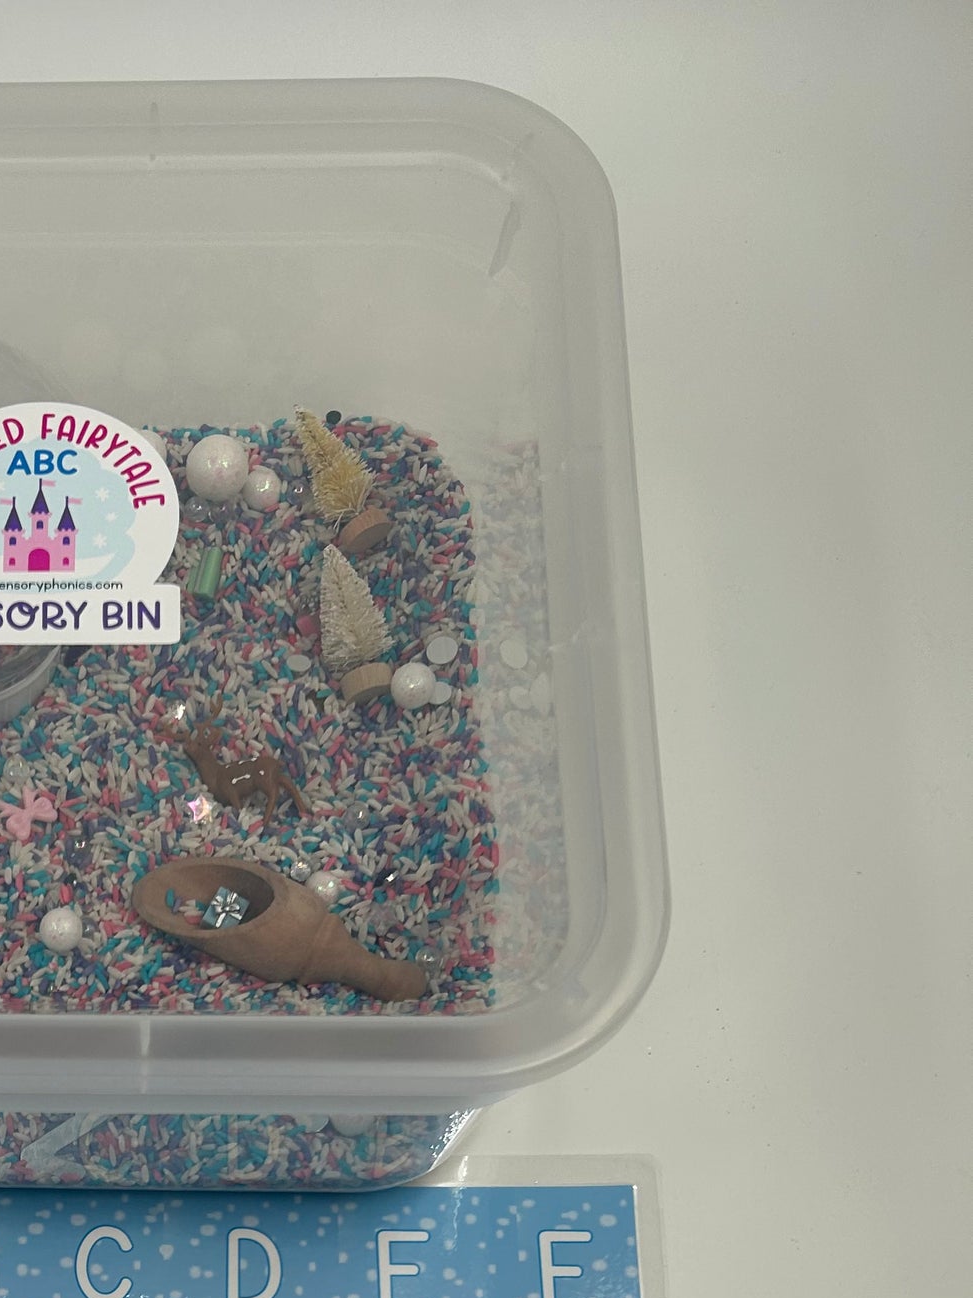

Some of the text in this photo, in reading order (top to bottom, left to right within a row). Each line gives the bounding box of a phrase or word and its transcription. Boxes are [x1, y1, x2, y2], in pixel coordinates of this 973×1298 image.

[6, 449, 78, 475] ABC
[40, 413, 166, 510] FAIRYTALE
[101, 601, 161, 631] BIN
